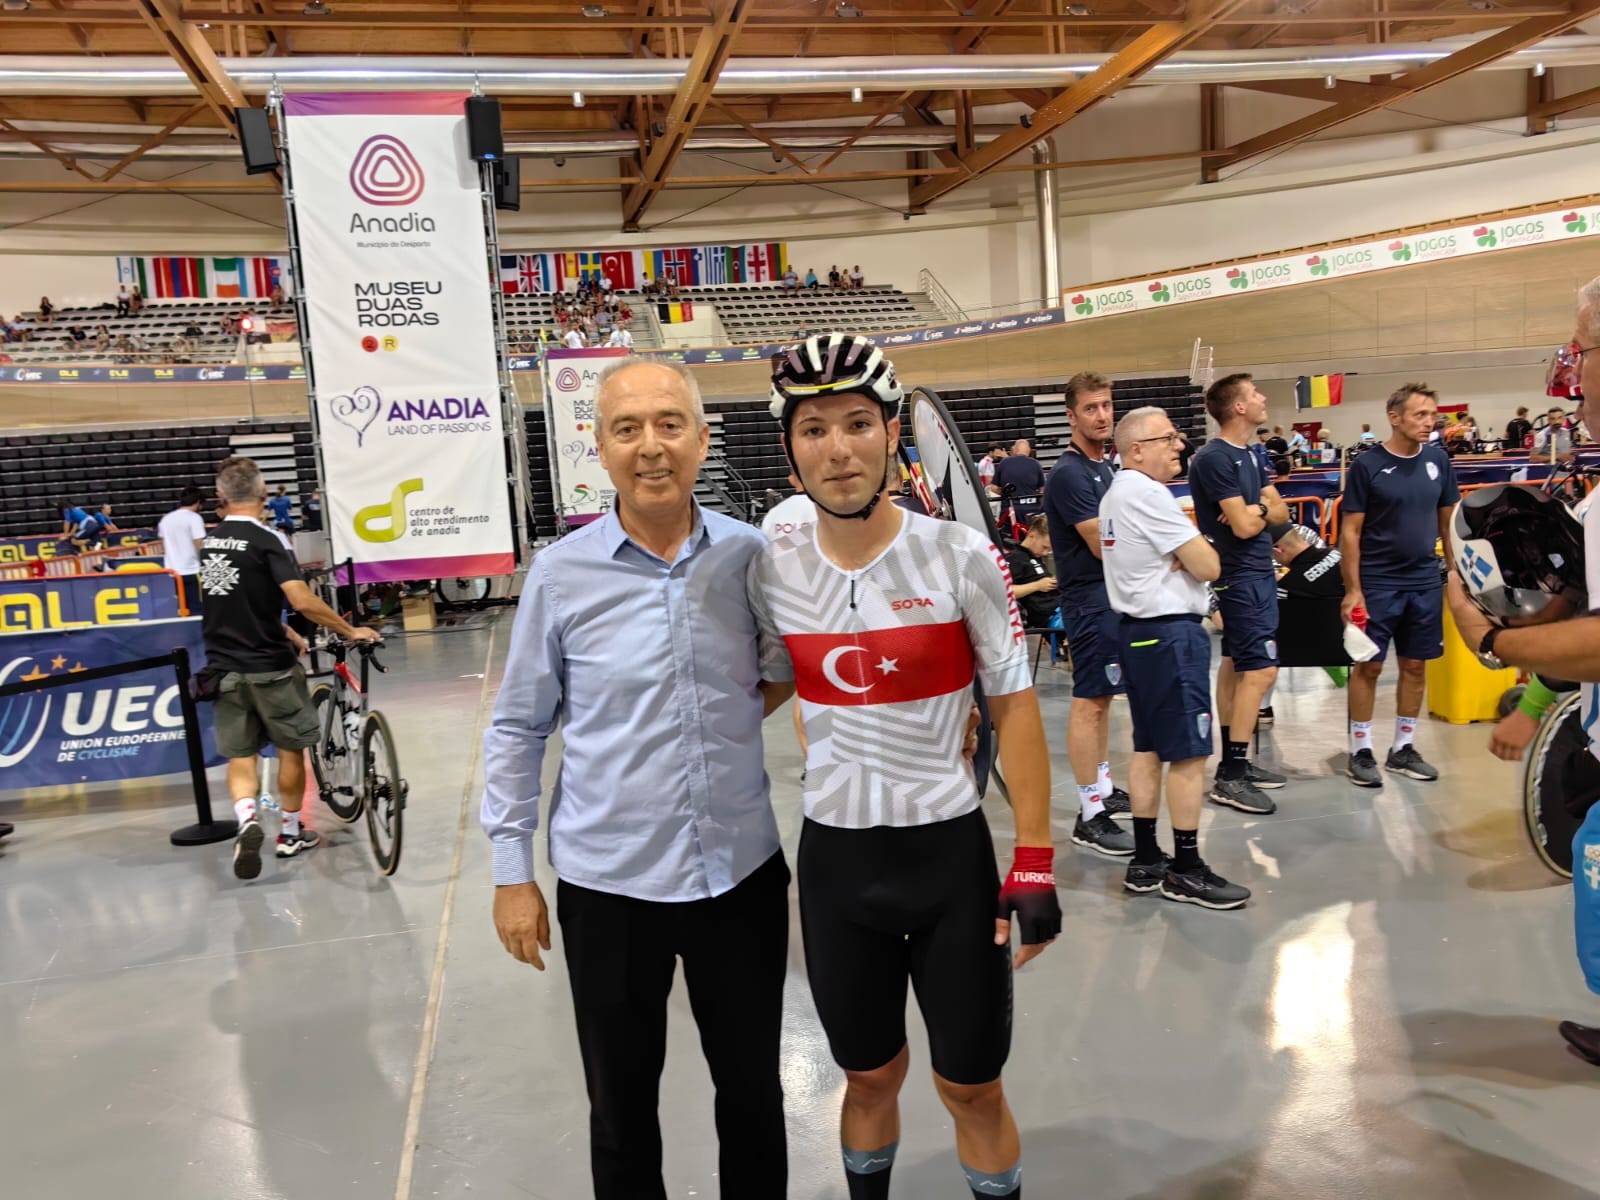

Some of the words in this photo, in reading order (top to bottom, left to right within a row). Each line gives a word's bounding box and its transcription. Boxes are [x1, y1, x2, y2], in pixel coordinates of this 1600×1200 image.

[349, 212, 436, 233] Anadia
[1500, 220, 1545, 242] JOGOS
[1414, 235, 1457, 257] JOGOS
[1332, 249, 1373, 273] JOGOS
[1251, 263, 1291, 284] JOGOS
[355, 281, 442, 296] MUSEU
[1173, 277, 1212, 297] JOGOS
[357, 297, 423, 312] DUAS
[1096, 289, 1135, 310] JOGOS
[358, 312, 440, 327] RODAS
[387, 397, 490, 421] ANADIA
[388, 424, 418, 436] LAND
[420, 424, 437, 435] OF
[438, 421, 492, 433] PASSIONS
[409, 508, 441, 516] centro
[442, 506, 454, 515] de
[410, 517, 430, 526] alto
[433, 515, 490, 525] rendimento
[411, 528, 423, 537] de
[426, 526, 461, 536] anadia
[1303, 549, 1342, 582] GERMAN
[61, 684, 186, 736] UEC
[60, 738, 103, 750] UNION
[104, 730, 187, 747] EUROPÉENNE
[57, 751, 76, 762] DE
[77, 746, 141, 760] CYCLISME
